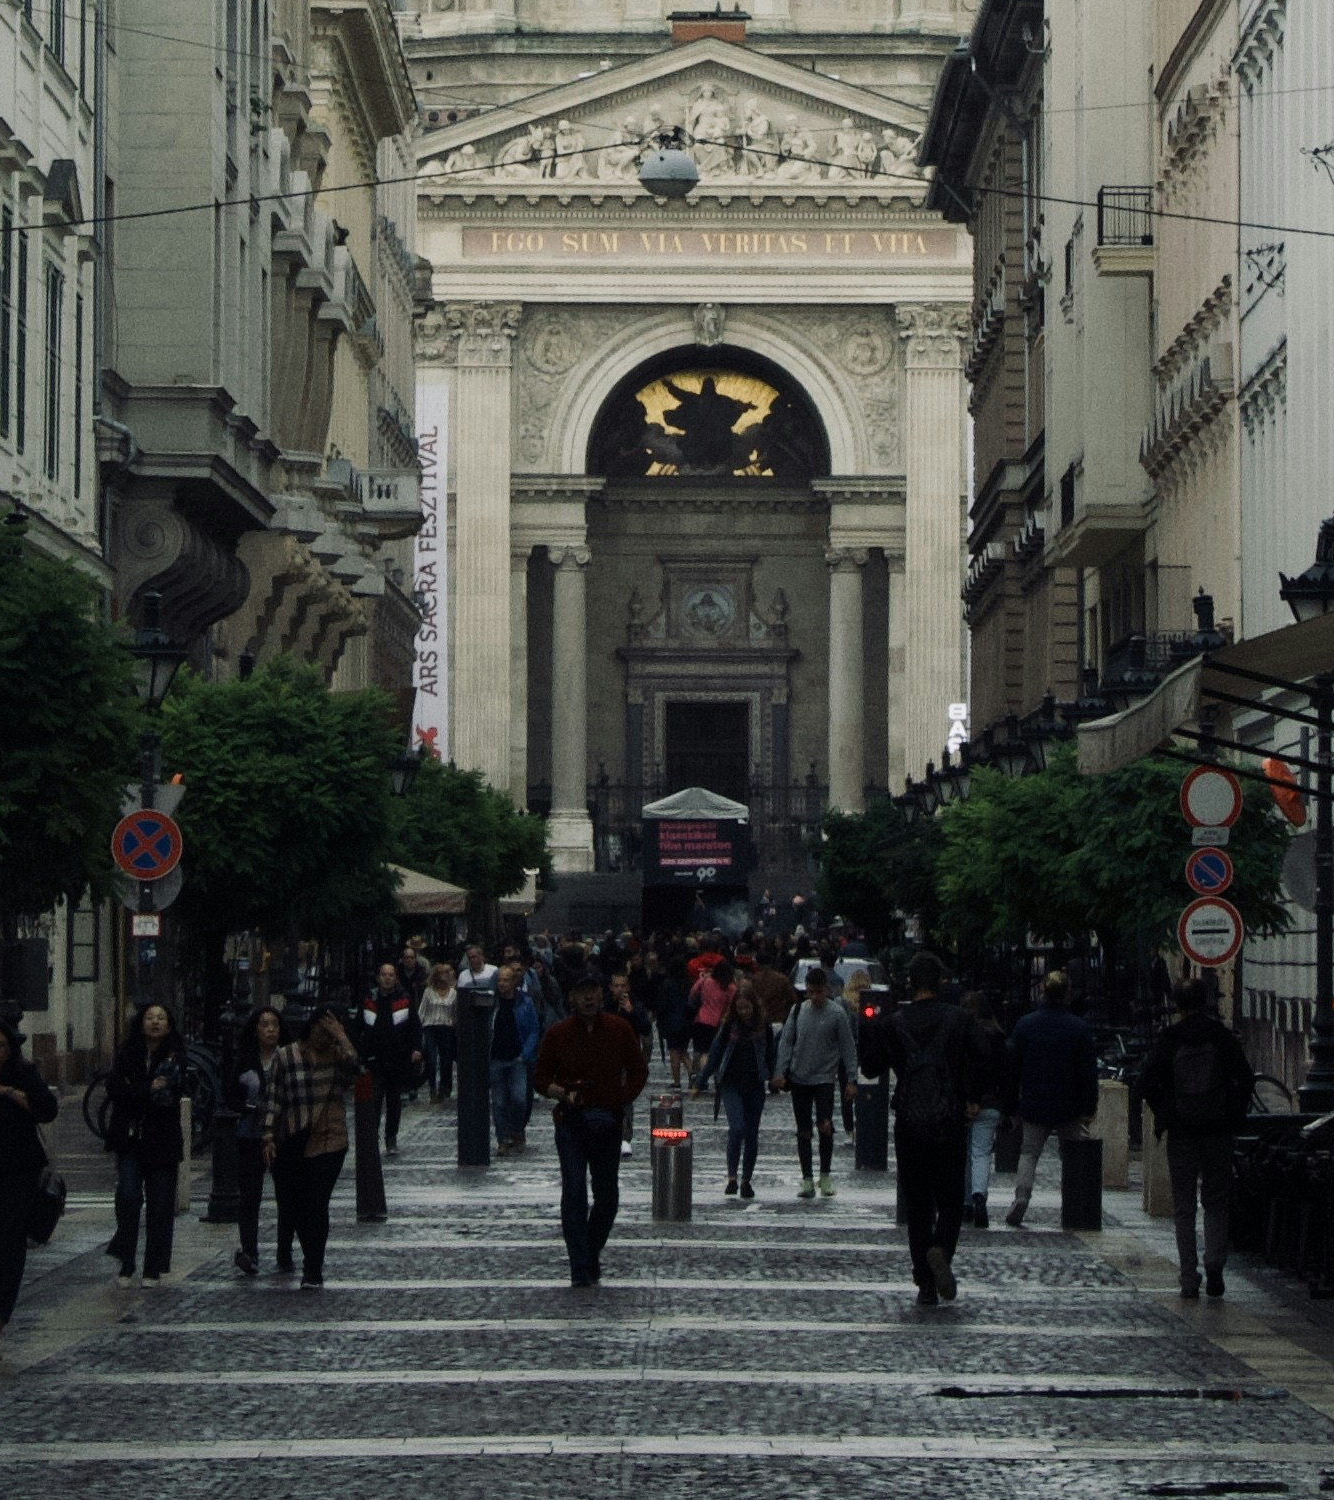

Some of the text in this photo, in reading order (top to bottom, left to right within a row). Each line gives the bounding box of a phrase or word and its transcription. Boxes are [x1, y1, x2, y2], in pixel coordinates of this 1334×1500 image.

[491, 232, 927, 254] EGO SUM VIA VERITAS ET VITA
[419, 651, 438, 697] ARS
